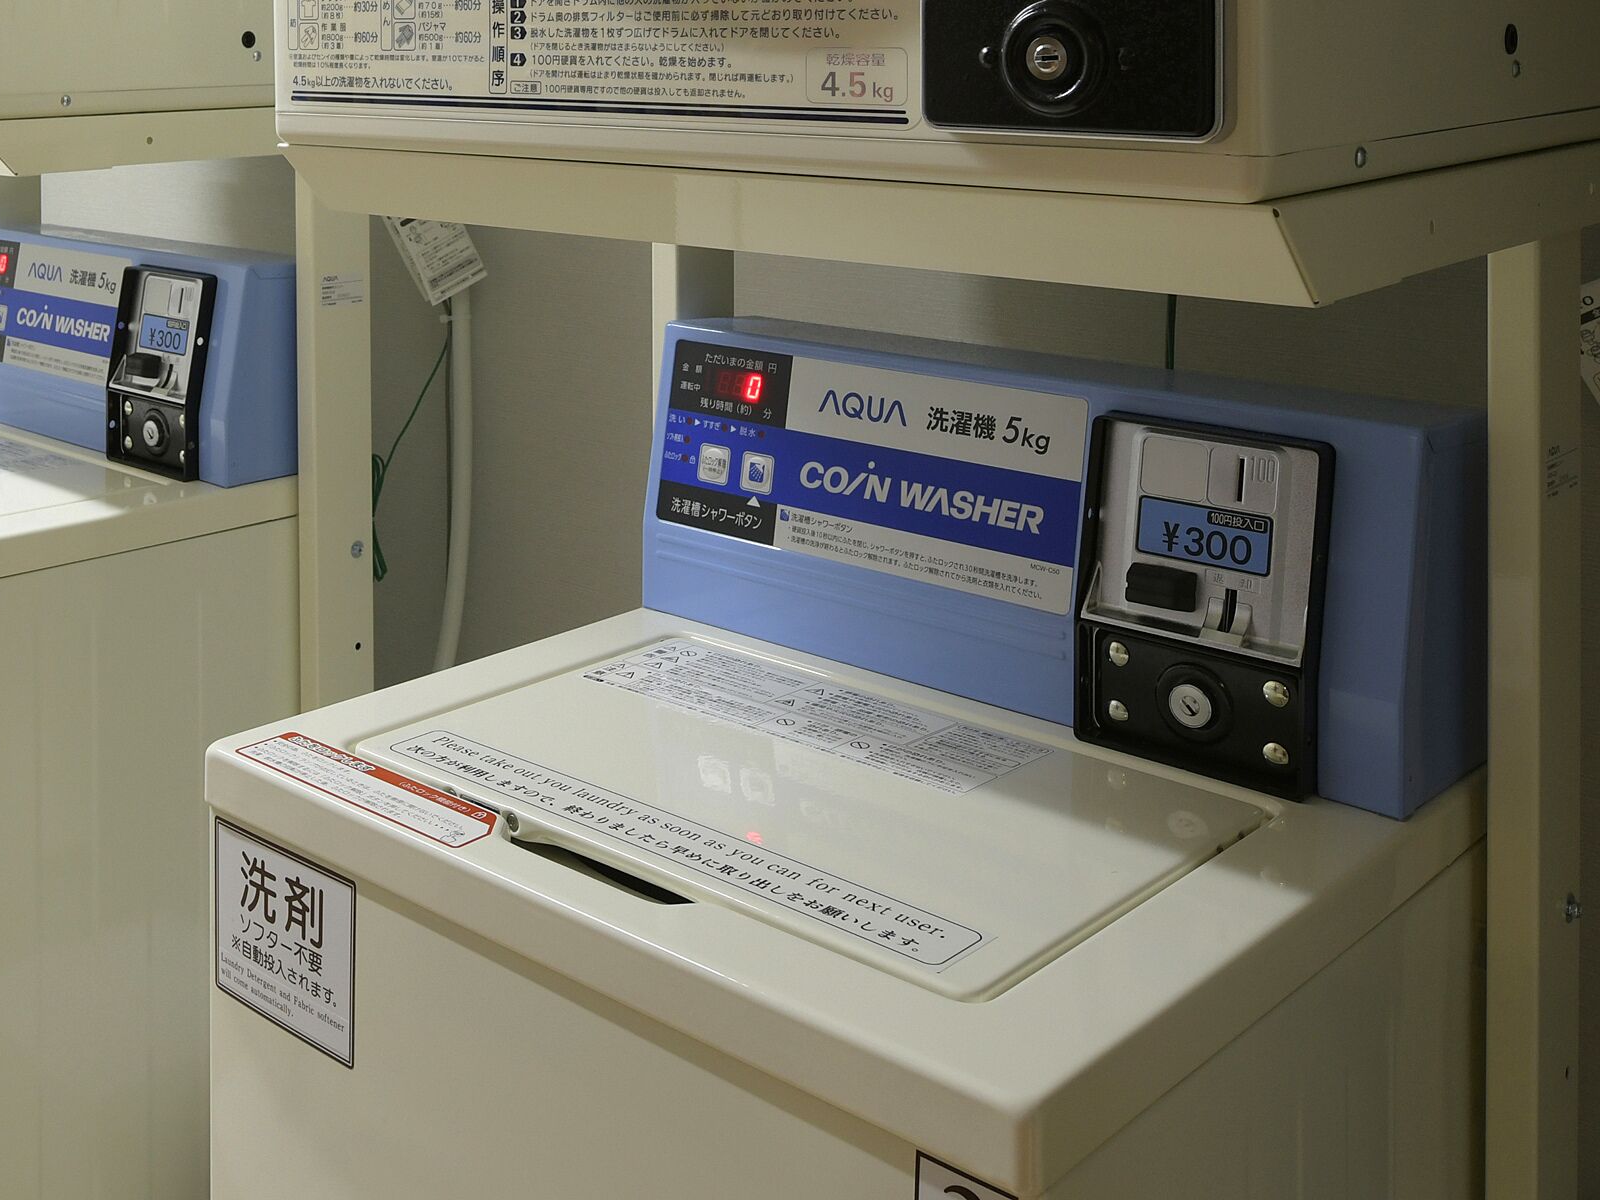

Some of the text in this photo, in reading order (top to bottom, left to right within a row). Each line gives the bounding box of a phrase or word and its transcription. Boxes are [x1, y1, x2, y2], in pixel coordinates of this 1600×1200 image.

[353, 0, 378, 13] 約30分
[454, 0, 482, 11] 約60分
[353, 31, 379, 44] 約60分
[454, 31, 482, 44] 約60分
[826, 53, 886, 67] 乾燥容量
[292, 75, 453, 92] 4.5kg以上の洗濯物を入れないでください。
[513, 83, 538, 93] ご注意
[0, 254, 8, 272] 0
[27, 262, 63, 283] AQUA
[97, 271, 117, 295] 5kg
[16, 303, 111, 343] COIN WASHER
[148, 327, 182, 350] ¥300
[704, 353, 778, 375] ただいまの金額 円
[746, 376, 762, 399] 0
[818, 389, 1051, 456] AQUA 洗濯機 5kg
[1249, 454, 1276, 484] 100
[799, 459, 1045, 535] COIN WASHER
[670, 496, 764, 530] 洗濯槽シャワーボタン
[790, 512, 854, 534] 洗濯槽シャワーボタン
[1210, 512, 1265, 532] 100円投入口
[1162, 521, 1252, 566] ¥300
[405, 743, 921, 953] 次の方が利用しますので、終わりましたら早めに取り出しをお願いします。
[431, 735, 946, 940] Please take out you laundry as soon as you can for next user.
[240, 850, 325, 949] 洗剤
[240, 913, 323, 978] ソフター不要
[230, 933, 337, 1008] ※自動投入されます。
[220, 951, 345, 1034] Laundry Detergent and Fabric softener
[220, 966, 295, 1019] will come automatically.
